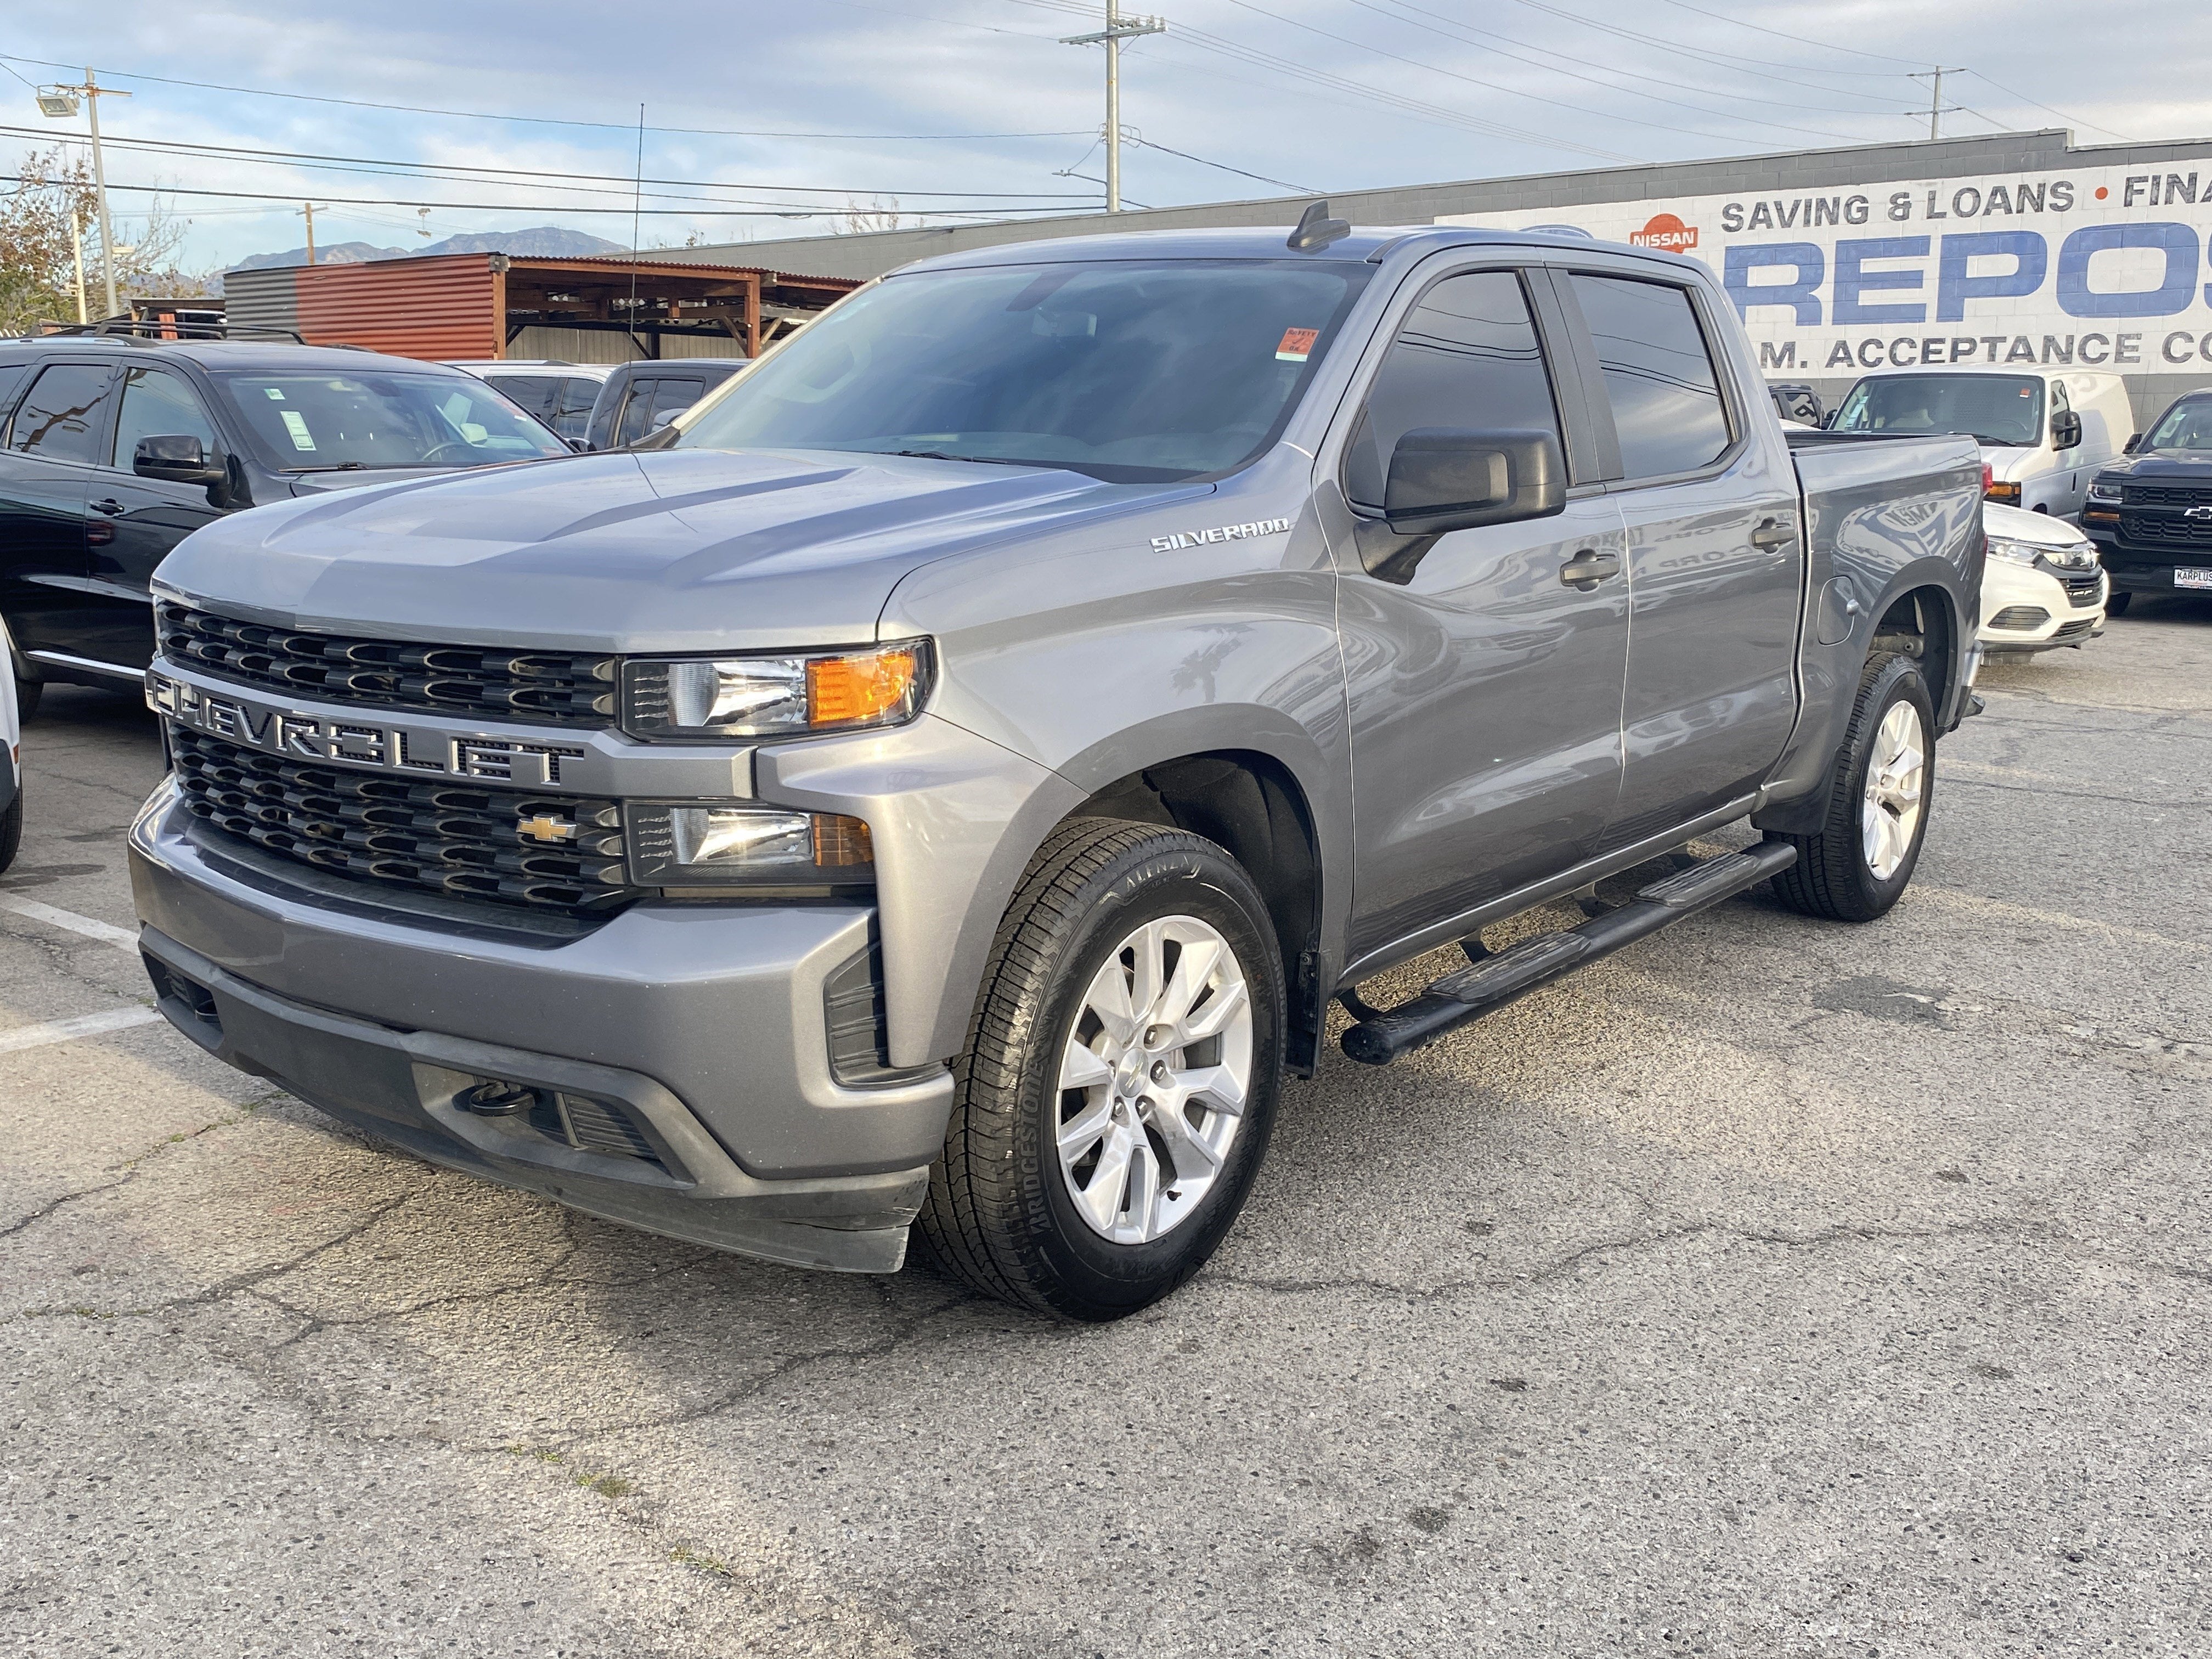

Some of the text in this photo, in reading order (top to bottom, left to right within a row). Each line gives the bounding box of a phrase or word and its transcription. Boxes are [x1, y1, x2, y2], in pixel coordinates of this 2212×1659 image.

[1721, 171, 2212, 233] SAVING & LOANS FIN
[1633, 231, 1695, 247] NISSAN
[1723, 222, 2212, 329] REPO
[1825, 333, 2142, 368] ACCEPTANCE
[1149, 517, 1290, 553] SILVERADO
[2177, 571, 2212, 582] KARPLUS
[153, 676, 585, 787] CHEVROLET
[1127, 854, 1189, 891] ALENZA
[1020, 1060, 1052, 1234] BRIDGESTONE
